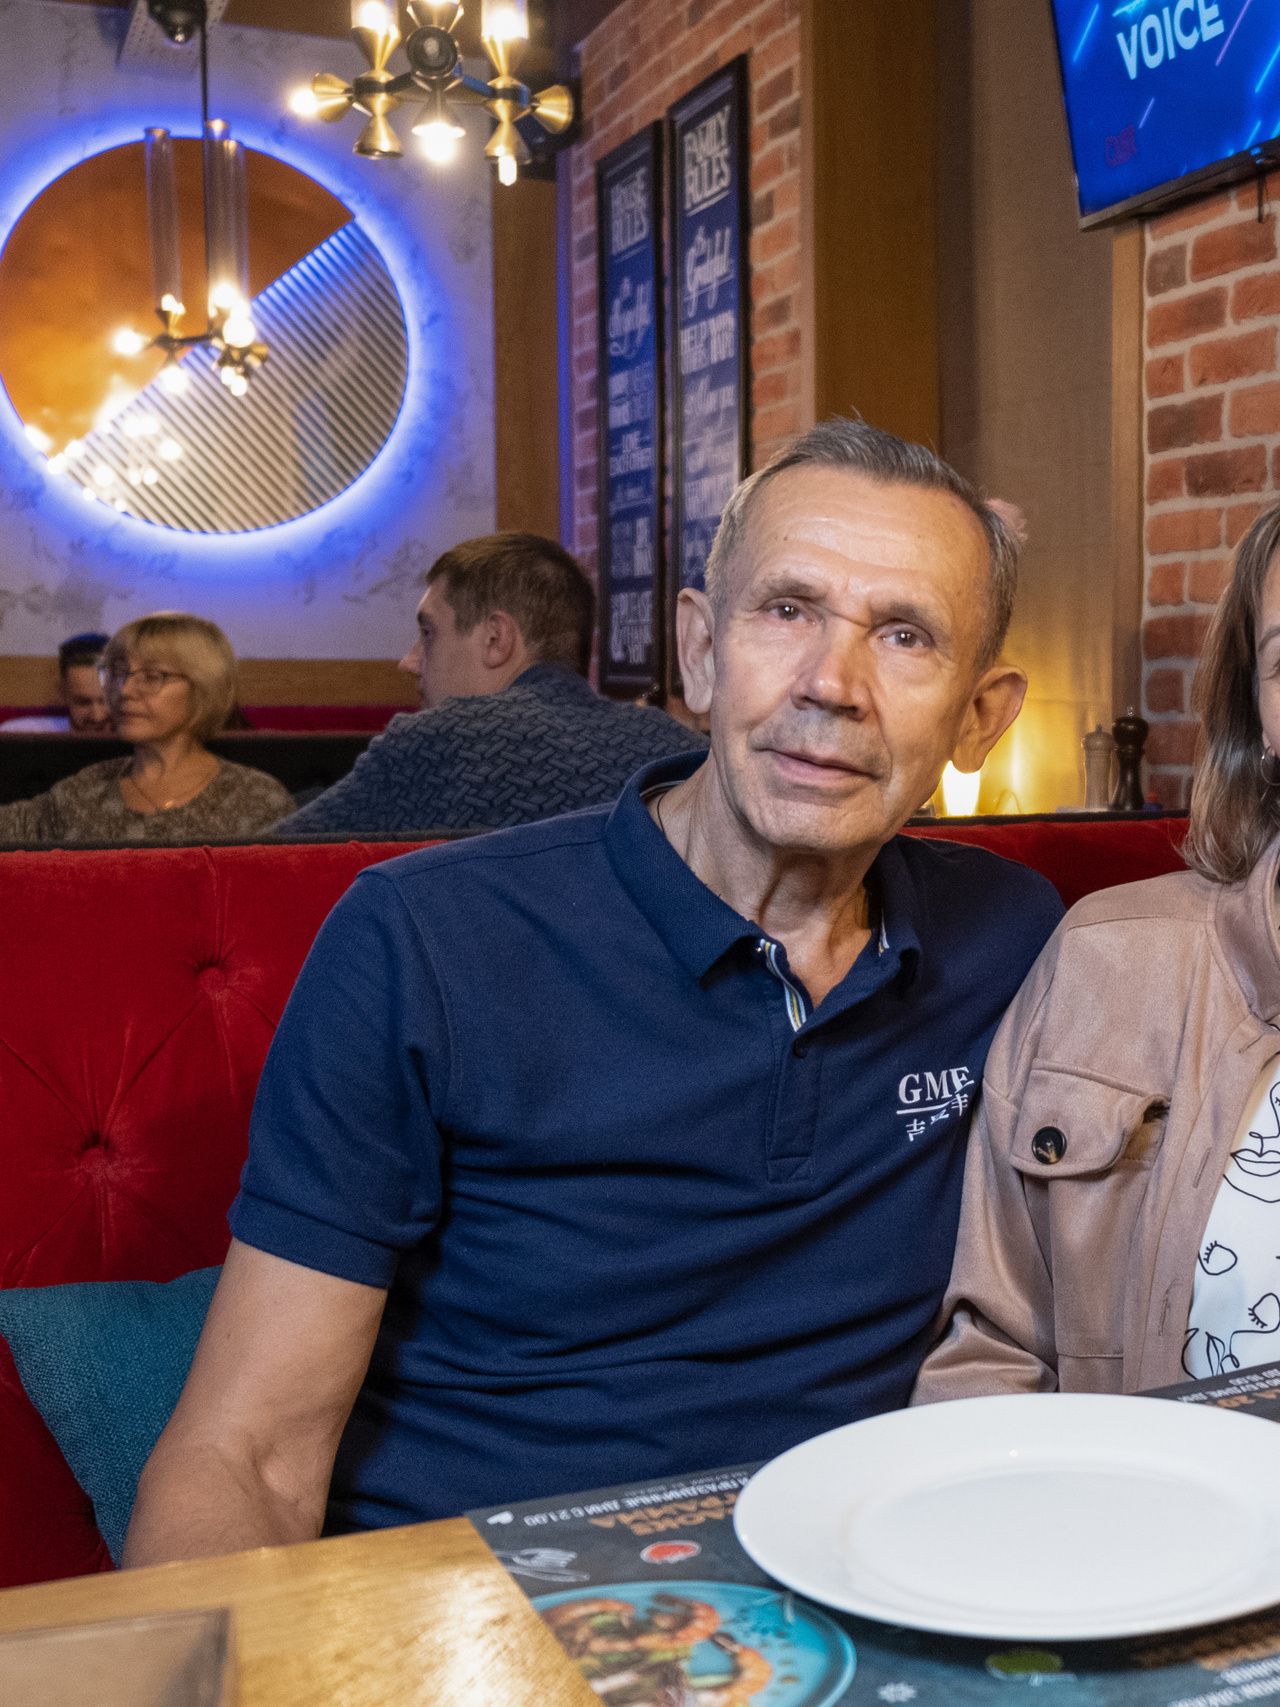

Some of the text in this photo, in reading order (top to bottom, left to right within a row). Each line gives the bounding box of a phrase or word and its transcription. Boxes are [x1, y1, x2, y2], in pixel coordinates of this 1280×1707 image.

[1116, 0, 1224, 80] VOICE
[684, 147, 731, 210] RULES
[1213, 1396, 1255, 1411] 20
[584, 1500, 620, 1515] ДНИ
[623, 1481, 737, 1507] ПРАЗДНИЧНЫЕ
[589, 1494, 741, 1528] ГРАММА
[630, 1507, 741, 1535] АОКЕ
